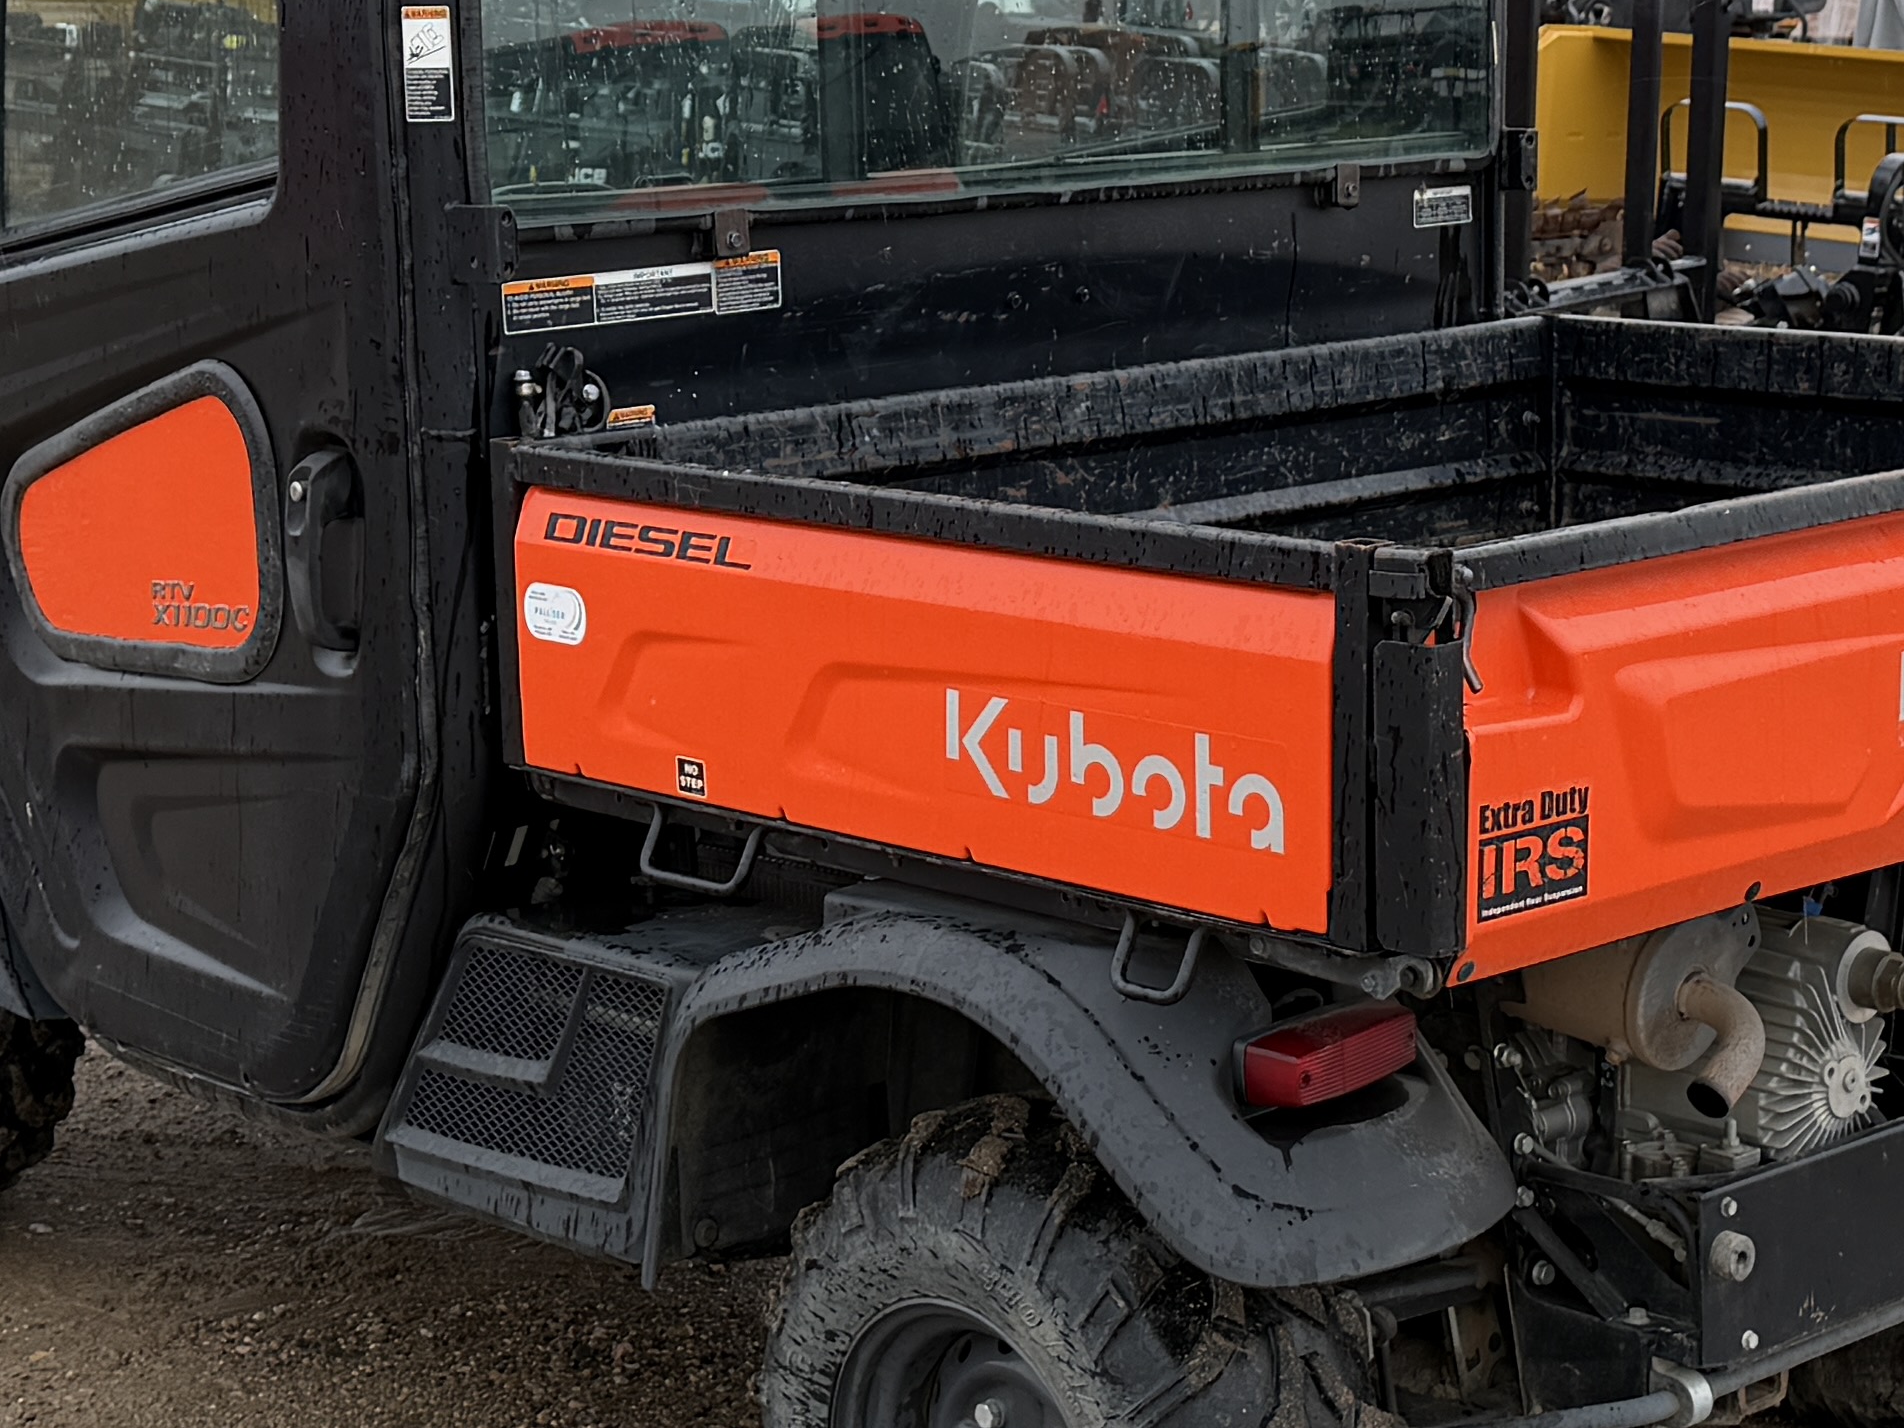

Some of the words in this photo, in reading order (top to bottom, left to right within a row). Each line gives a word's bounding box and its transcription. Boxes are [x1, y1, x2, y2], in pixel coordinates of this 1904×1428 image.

[544, 512, 751, 570] DIESEL
[152, 580, 194, 601] RTV
[153, 602, 249, 632] X1100C
[680, 775, 703, 789] STEP
[684, 763, 698, 776] NO
[946, 688, 1285, 854] Kubota
[1480, 800, 1534, 834] Extra
[1540, 786, 1589, 820] Duty
[1482, 826, 1585, 899] IRS
